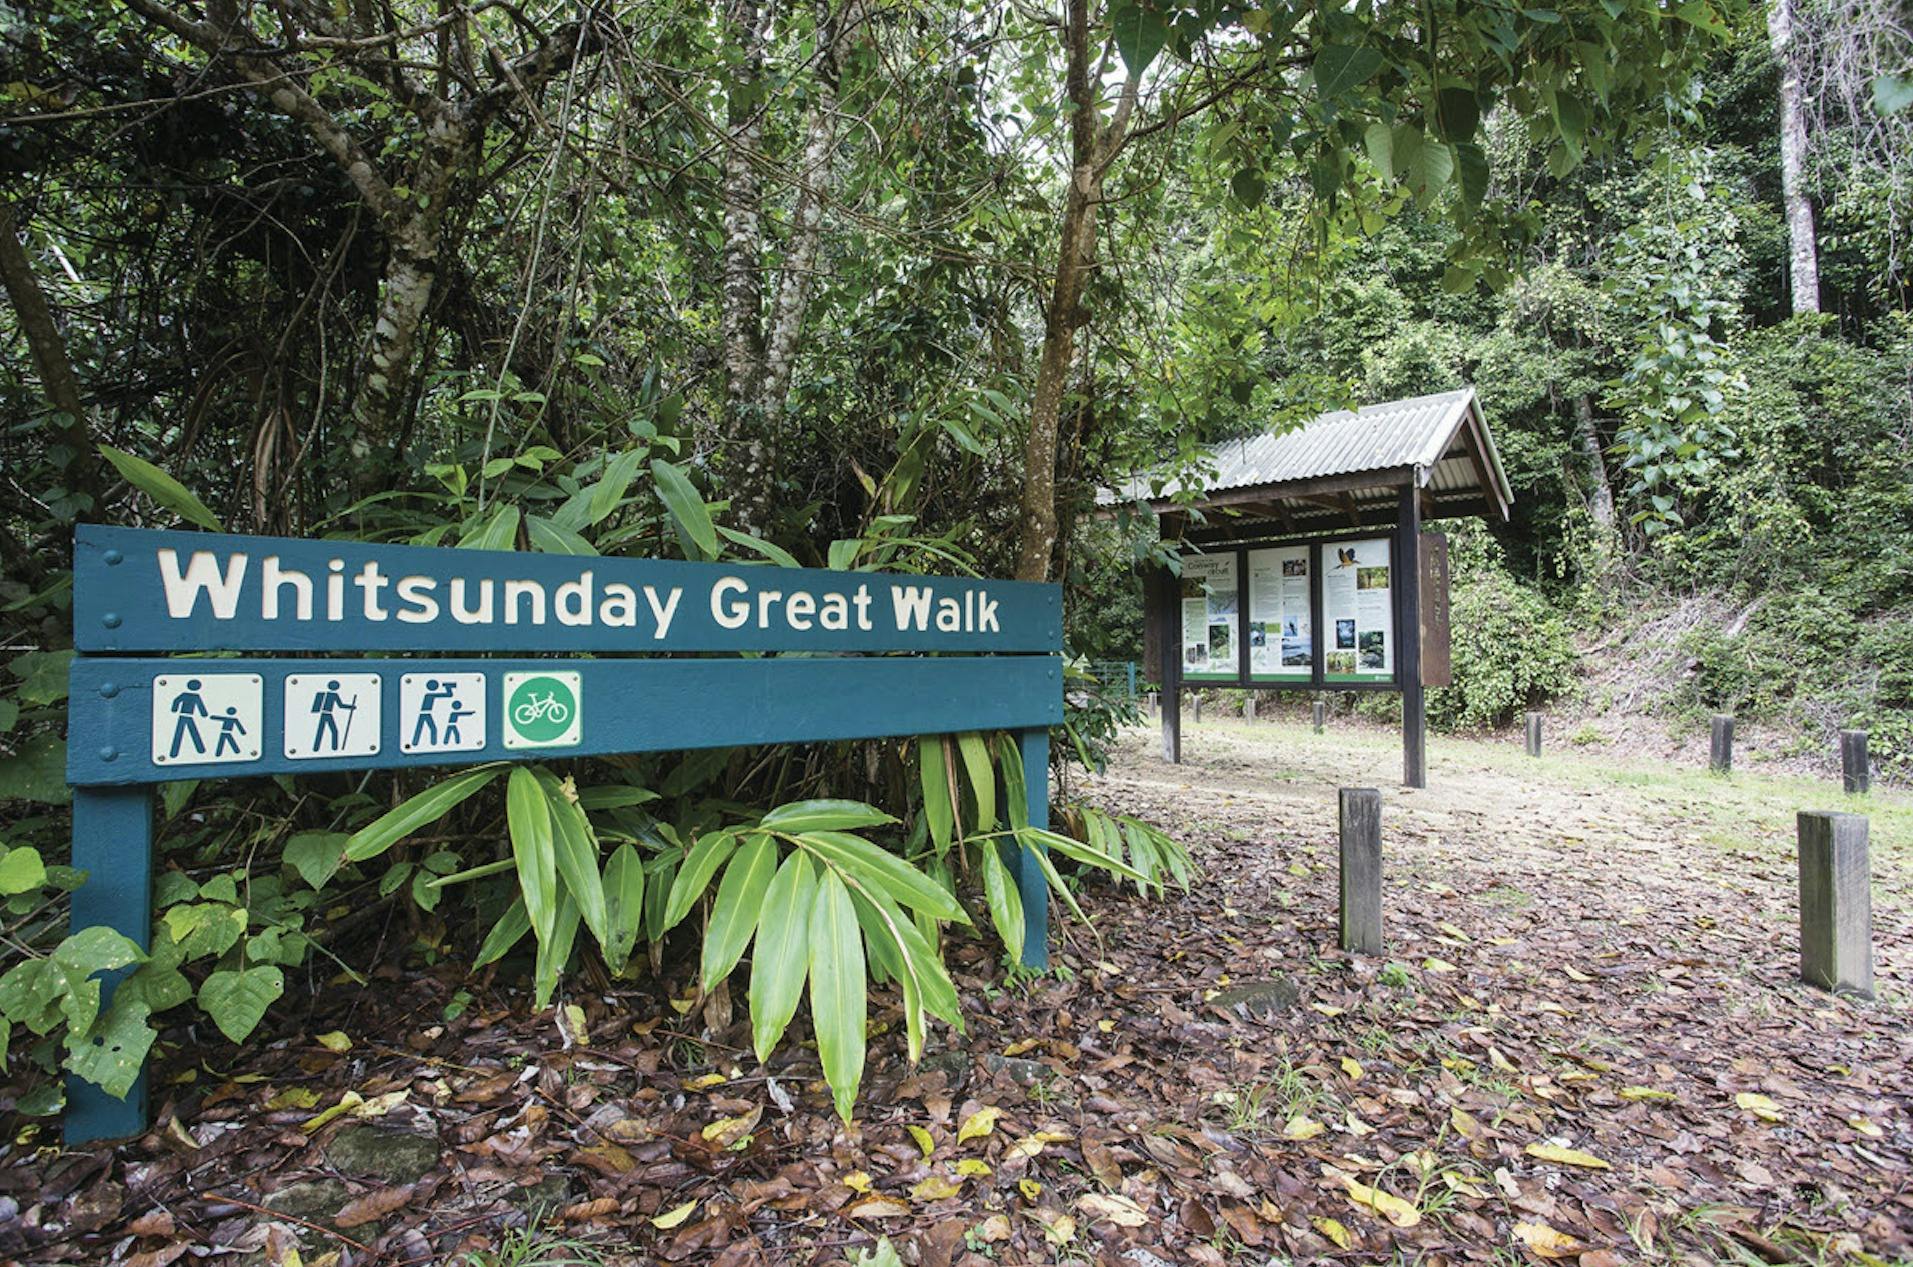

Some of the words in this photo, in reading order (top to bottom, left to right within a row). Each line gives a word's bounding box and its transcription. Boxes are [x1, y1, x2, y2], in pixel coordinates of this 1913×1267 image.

[157, 549, 683, 640] Whitsunday
[710, 576, 874, 631] Great
[891, 584, 1000, 633] Walk
